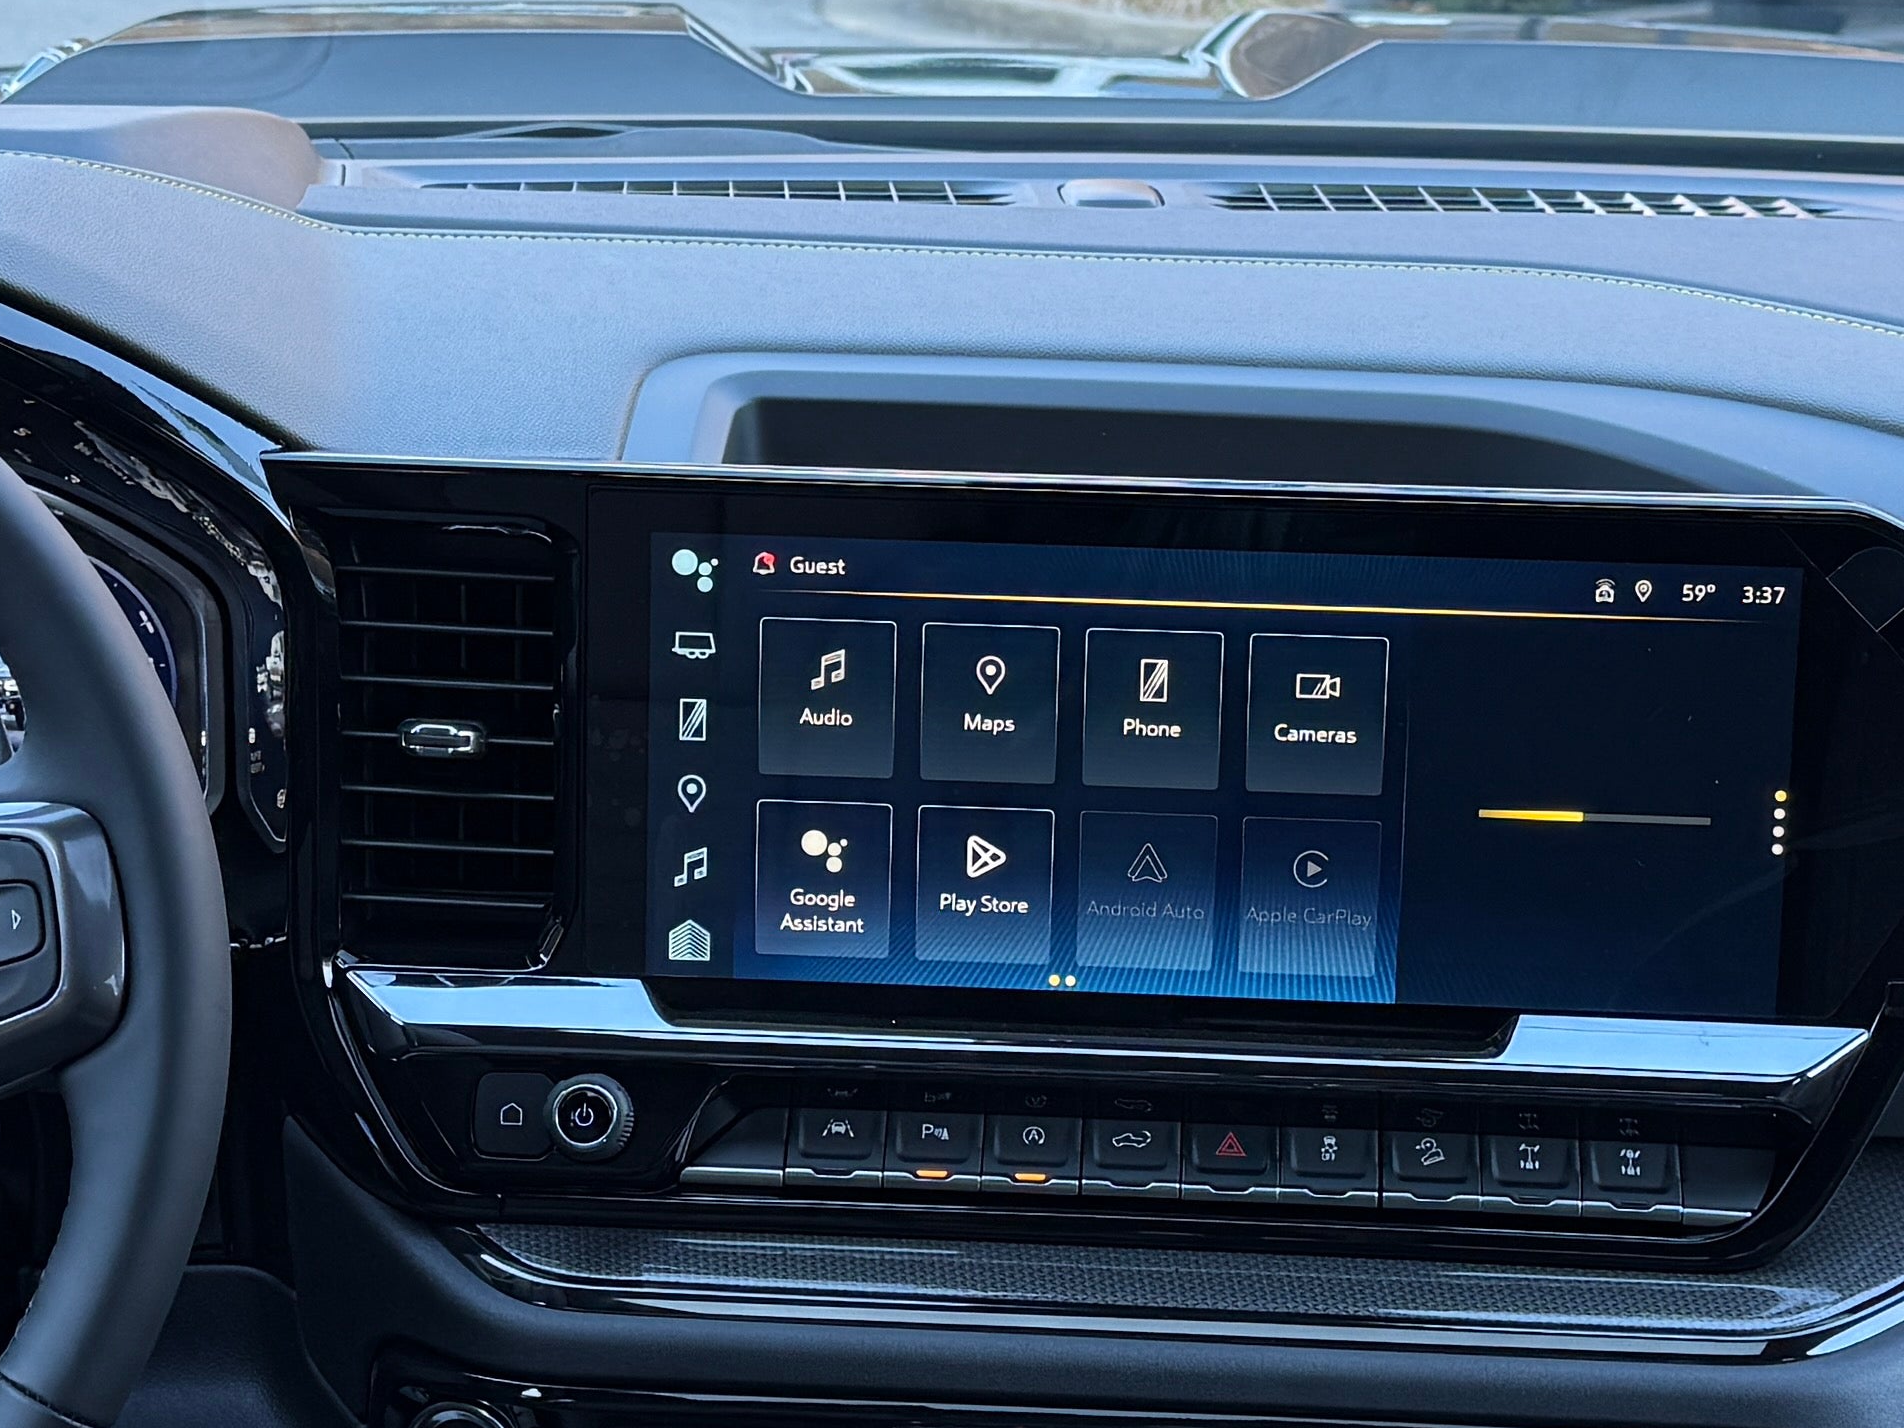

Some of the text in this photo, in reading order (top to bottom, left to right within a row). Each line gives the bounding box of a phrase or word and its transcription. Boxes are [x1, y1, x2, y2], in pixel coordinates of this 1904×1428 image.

[790, 556, 846, 576] Guest
[1742, 585, 1786, 604] 3:37
[800, 708, 853, 727] Audio
[963, 713, 1016, 735] Maps
[1123, 718, 1182, 737] Phone
[1273, 723, 1357, 745] Cameras
[789, 888, 856, 912] Google
[939, 894, 1029, 918] Play Store
[1087, 900, 1205, 920] Android Auto
[779, 912, 865, 935] Assistant
[1246, 906, 1373, 930] Apple CarPlay
